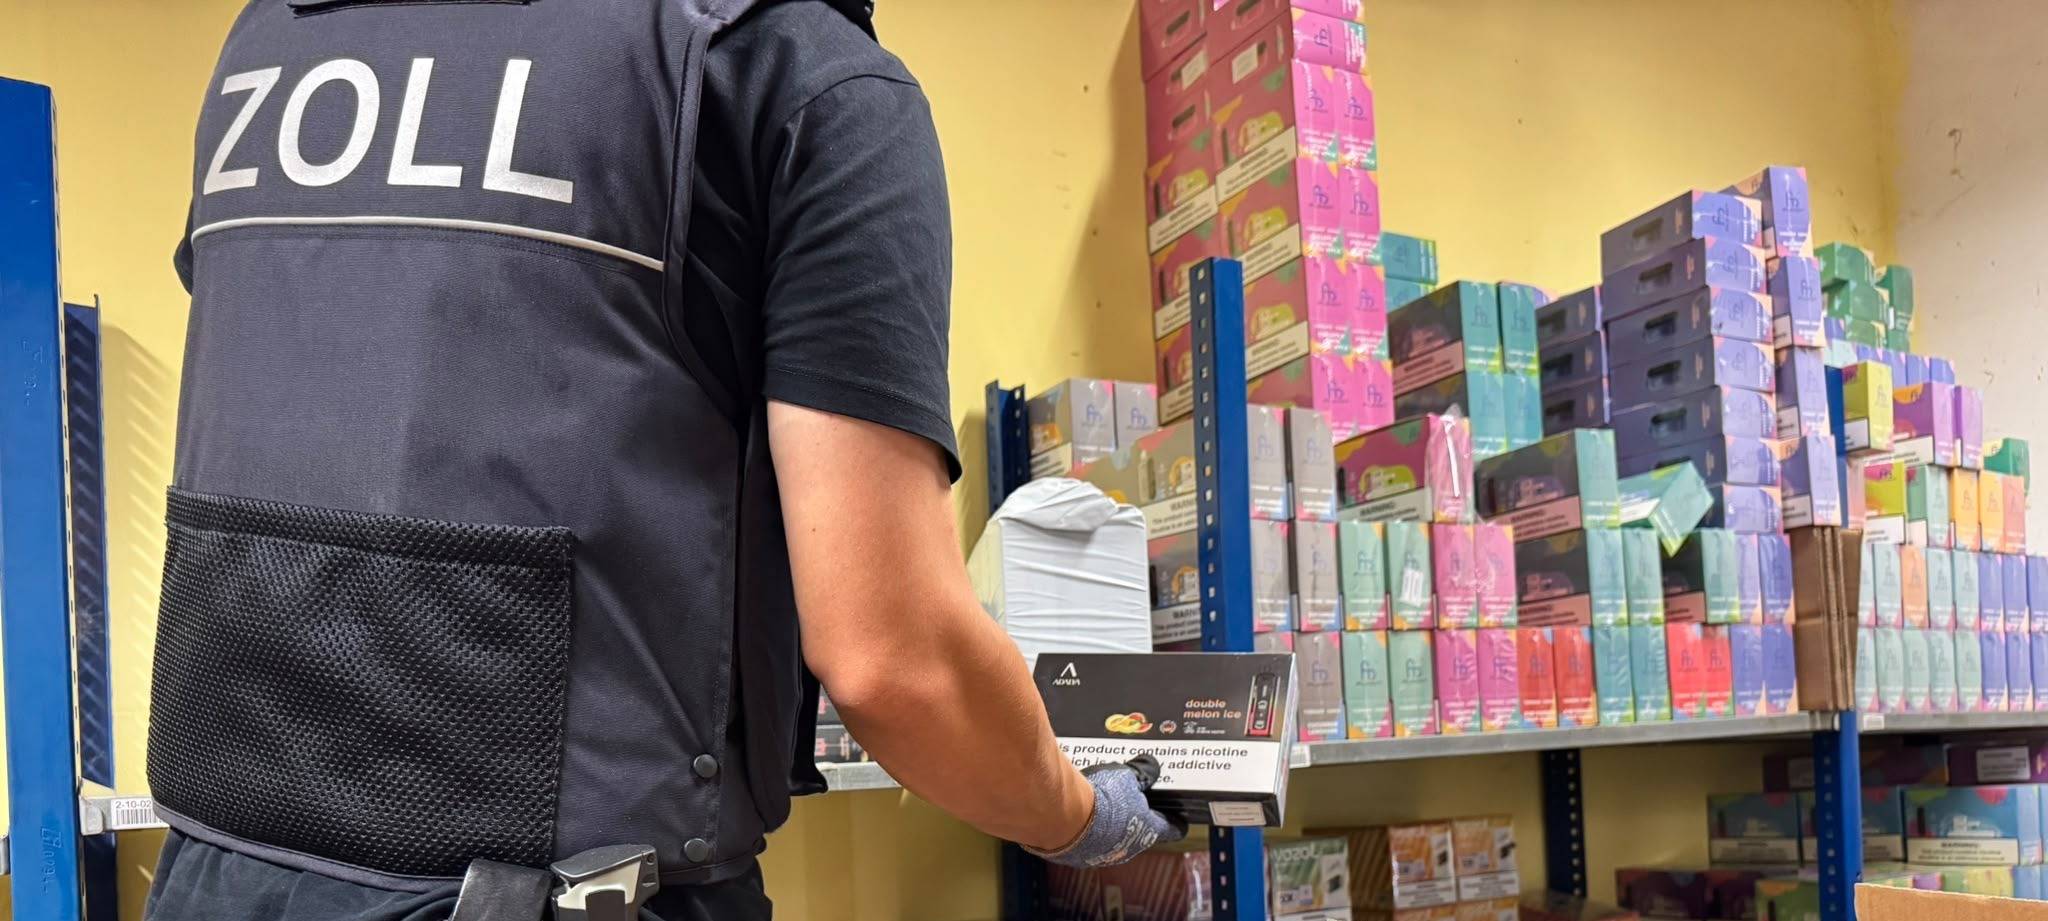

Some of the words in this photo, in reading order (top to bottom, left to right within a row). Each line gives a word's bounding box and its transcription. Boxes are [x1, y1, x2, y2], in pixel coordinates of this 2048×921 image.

[203, 57, 573, 203] ZOLL
[1052, 678, 1081, 686] ADADA
[1185, 699, 1226, 709] double
[1183, 709, 1220, 719] melon
[1223, 709, 1242, 719] ice
[1073, 745, 1125, 755] product
[1129, 747, 1187, 756] contains
[1192, 747, 1248, 757] nicotine
[1168, 760, 1232, 770] addictive
[115, 799, 152, 809] 2-10-02
